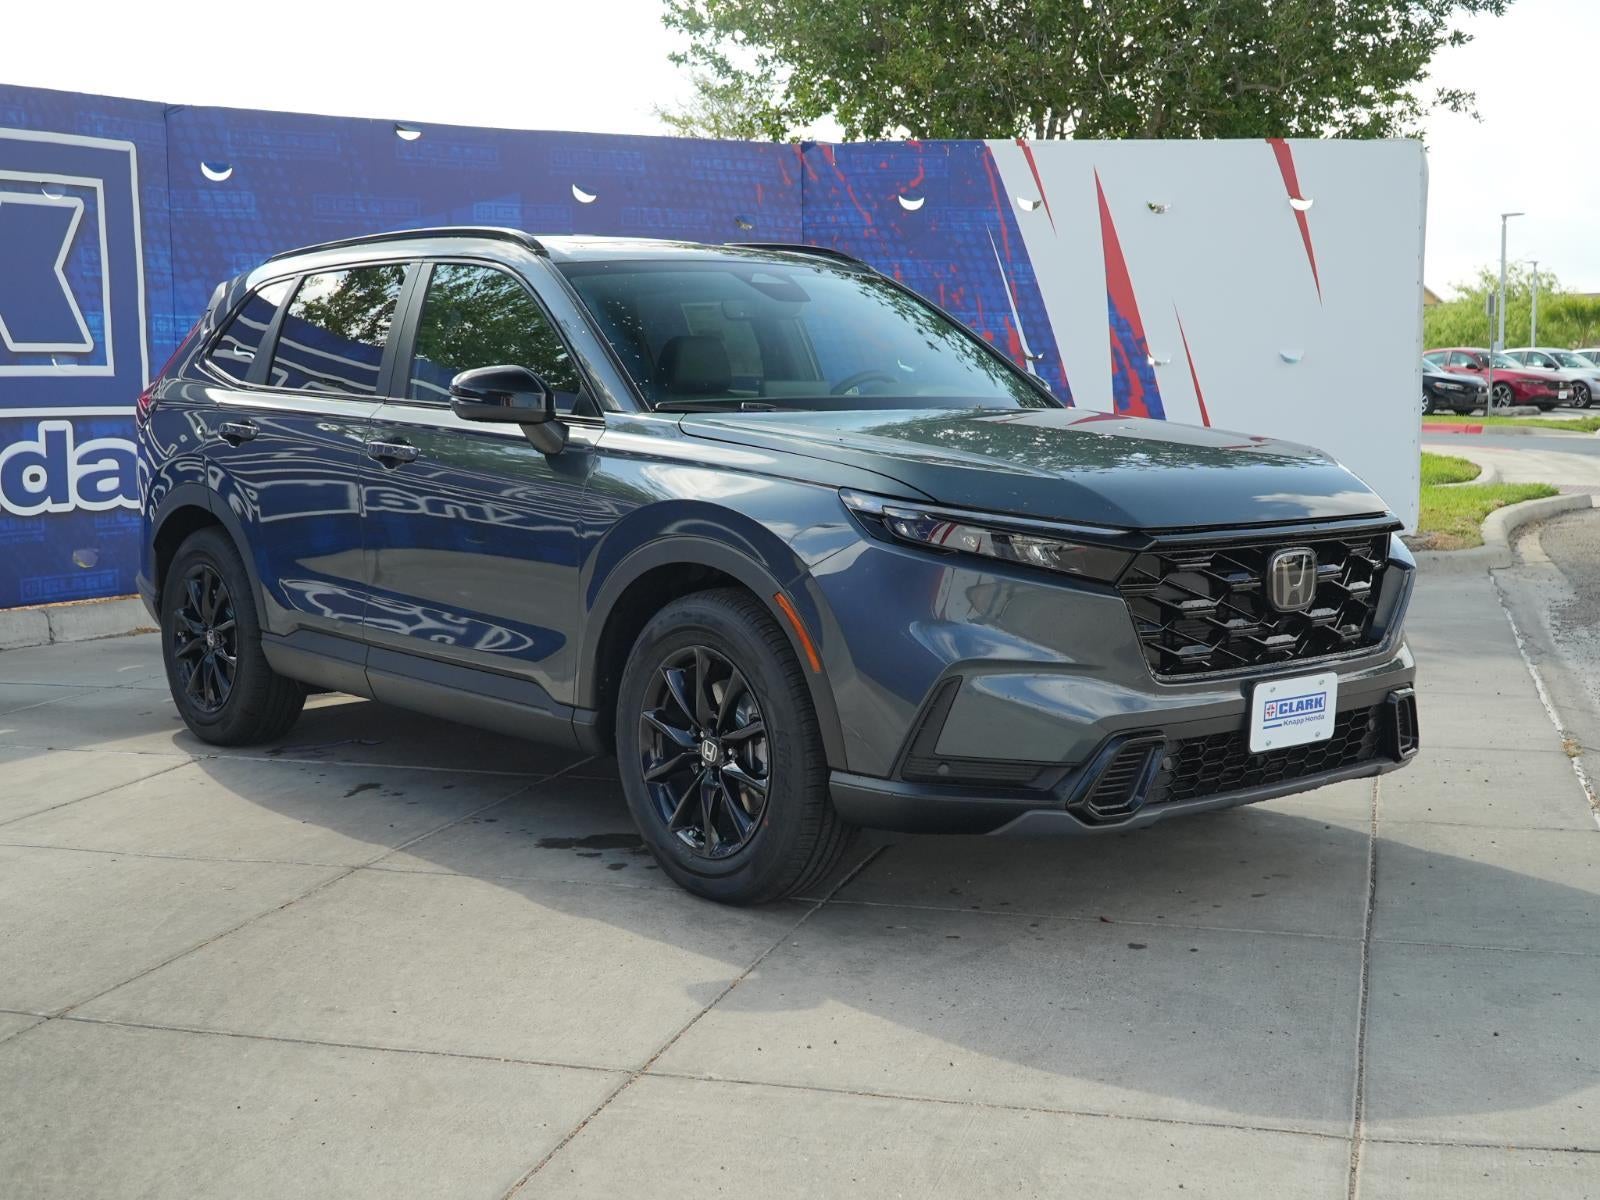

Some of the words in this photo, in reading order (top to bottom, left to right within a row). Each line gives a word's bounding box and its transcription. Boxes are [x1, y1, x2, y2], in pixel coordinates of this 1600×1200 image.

[1279, 697, 1323, 714] CLARK
[1283, 718, 1304, 726] Knapp
[1304, 714, 1325, 722] Honda
